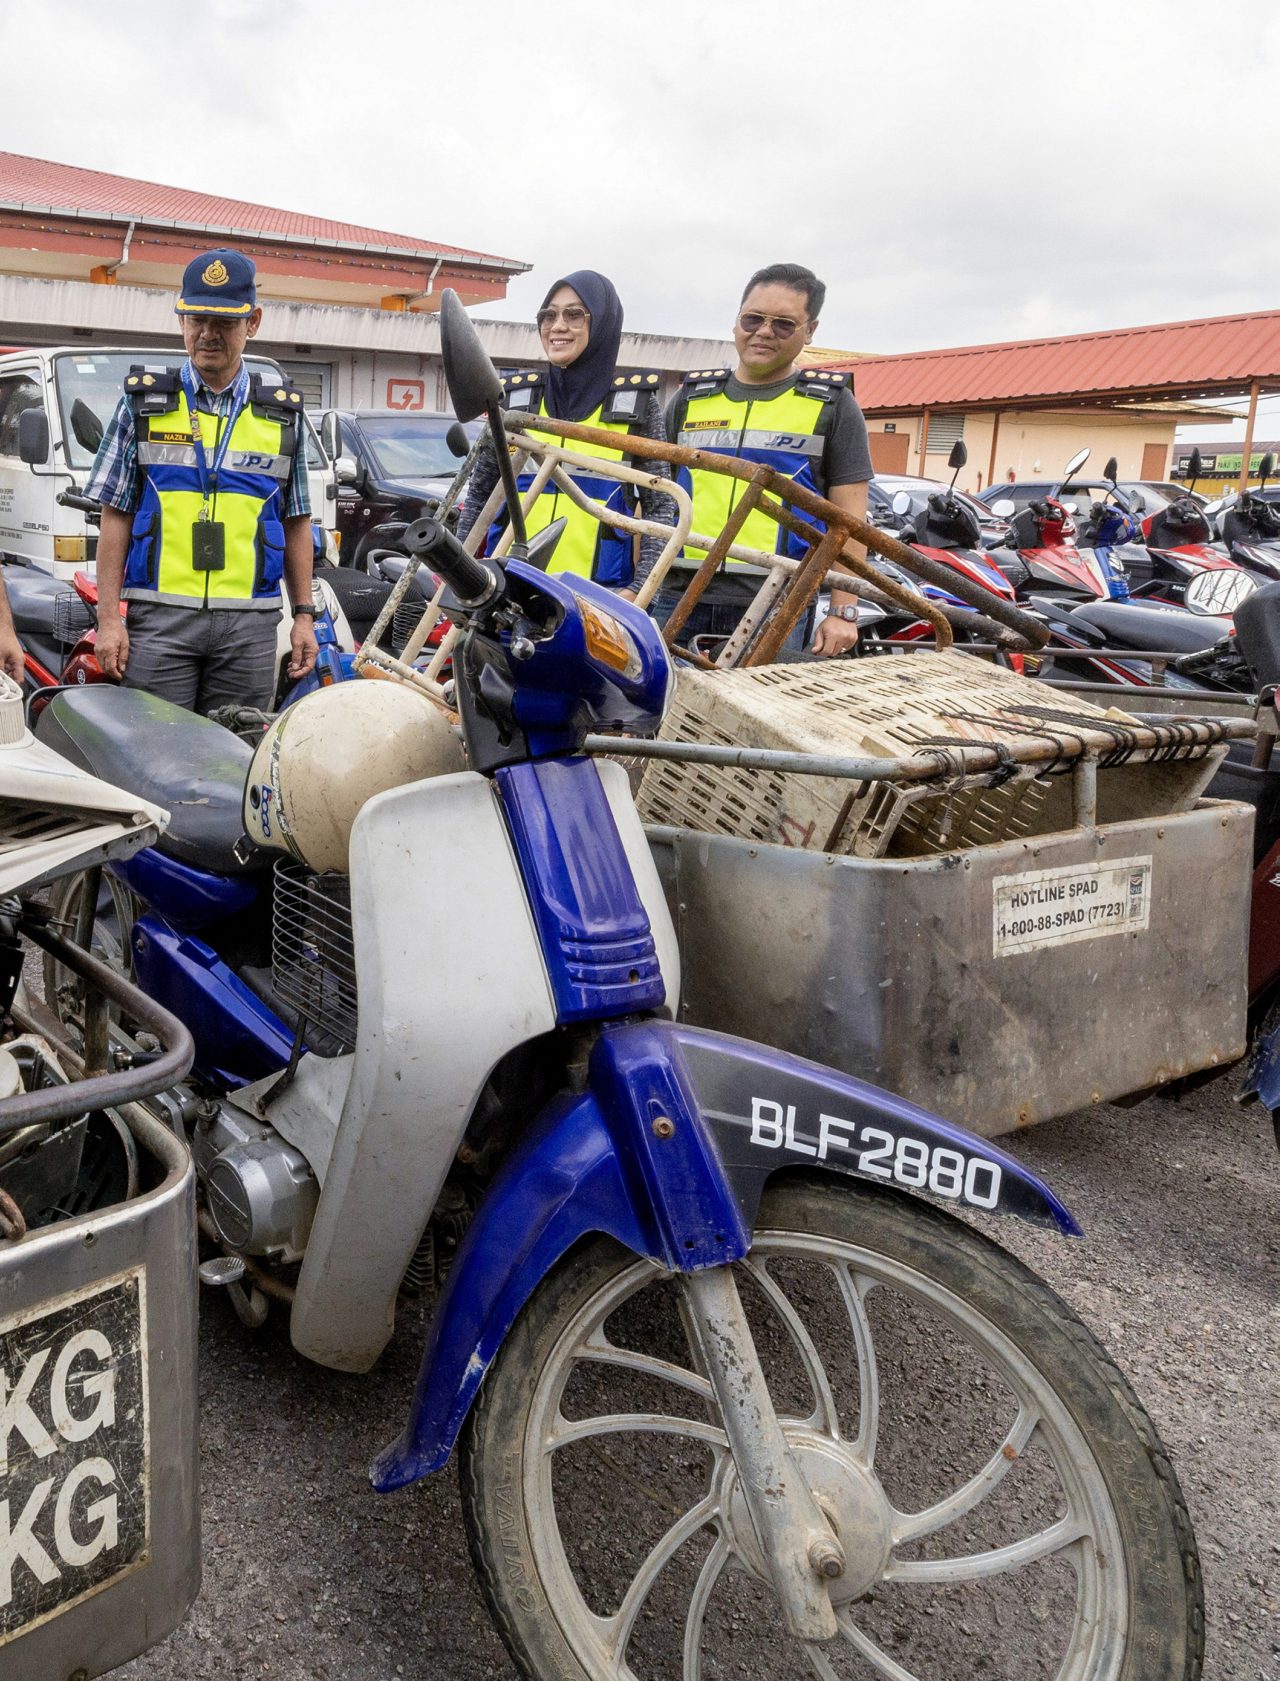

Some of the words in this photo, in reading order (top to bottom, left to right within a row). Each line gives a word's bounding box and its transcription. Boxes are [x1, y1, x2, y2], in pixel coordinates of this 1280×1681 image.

[163, 433, 187, 442] NAZILI
[765, 436, 807, 450] JPJ
[232, 455, 274, 470] JPJ
[1011, 885, 1065, 908] HOTLINE
[1068, 880, 1098, 898] SPAD
[1000, 909, 1085, 938] 1-800-88-SPAD
[1088, 902, 1125, 923] (7723)
[494, 1484, 525, 1580] VIVA
